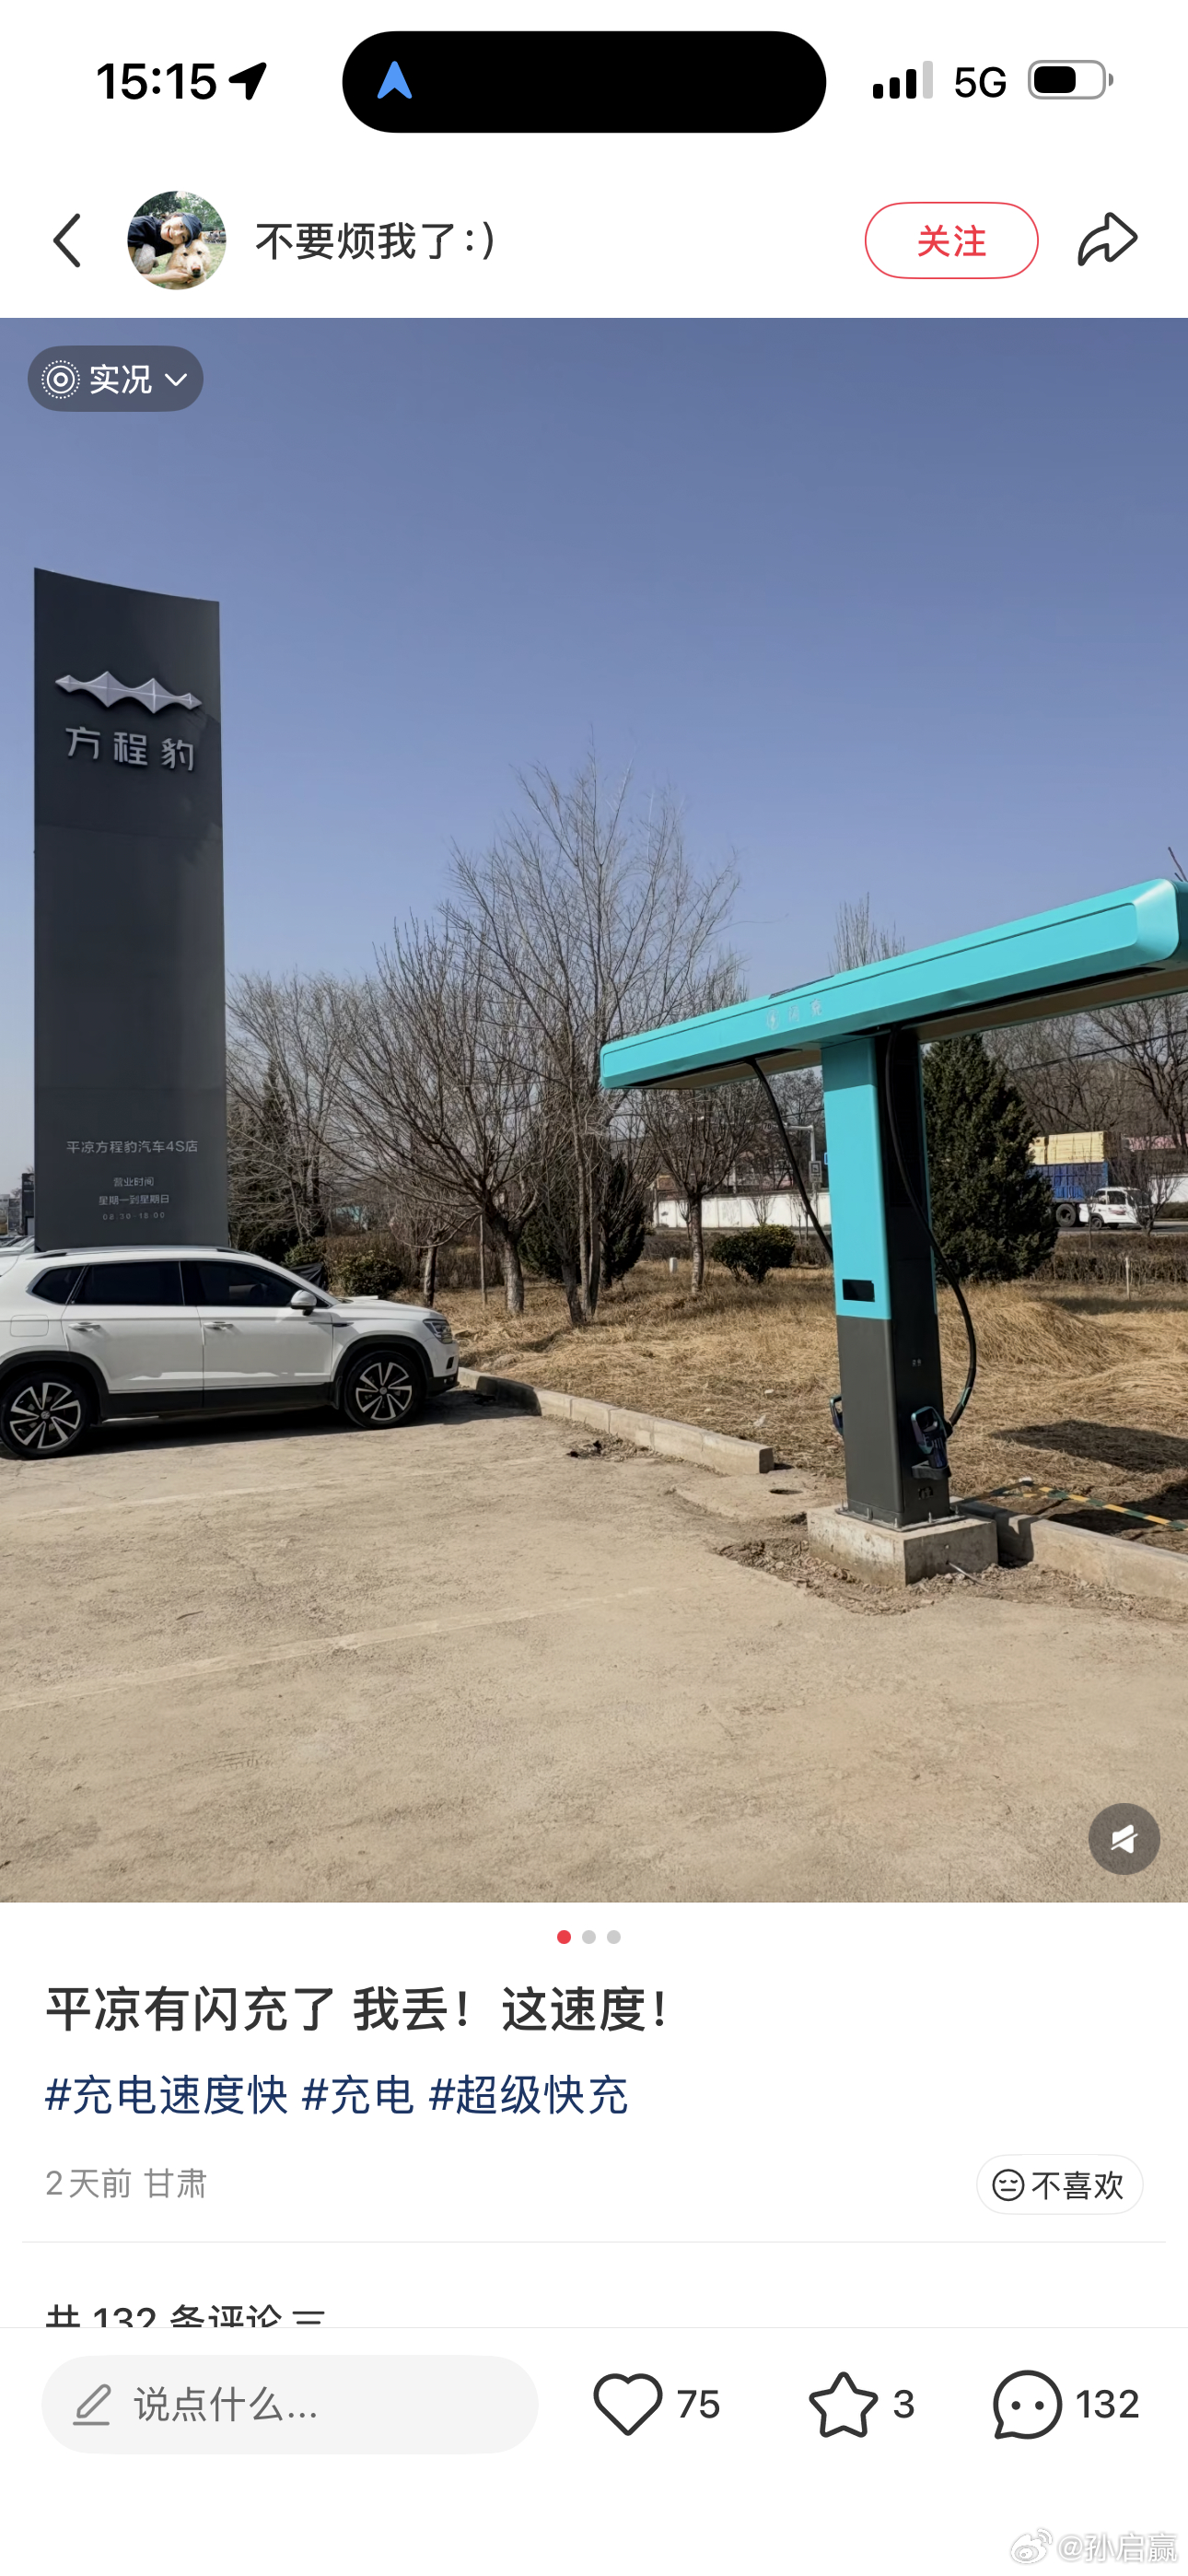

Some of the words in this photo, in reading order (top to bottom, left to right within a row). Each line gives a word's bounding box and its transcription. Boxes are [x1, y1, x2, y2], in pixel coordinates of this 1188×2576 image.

[98, 64, 217, 100] 15:15
[955, 66, 1007, 99] 5G
[917, 225, 986, 258] 关注
[89, 363, 153, 395] 实况
[65, 726, 194, 771] 方程豹
[66, 1141, 198, 1153] 平凉方程豹汽车4S店
[113, 1177, 155, 1188] 营业时间
[99, 1194, 169, 1206] 星期一到星期日
[46, 1985, 333, 2032] 平凉有闪充了
[45, 2073, 288, 2115] #充电速度快
[302, 2073, 414, 2115] #充电
[429, 2073, 629, 2115] #超级快充
[144, 2167, 207, 2199] 甘肃
[1031, 2170, 1124, 2201] 不喜欢
[94, 2307, 156, 2327] 132
[169, 2304, 282, 2327] 条评论
[678, 2389, 720, 2419] 75
[893, 2389, 914, 2419] 3
[1076, 2389, 1139, 2419] 132
